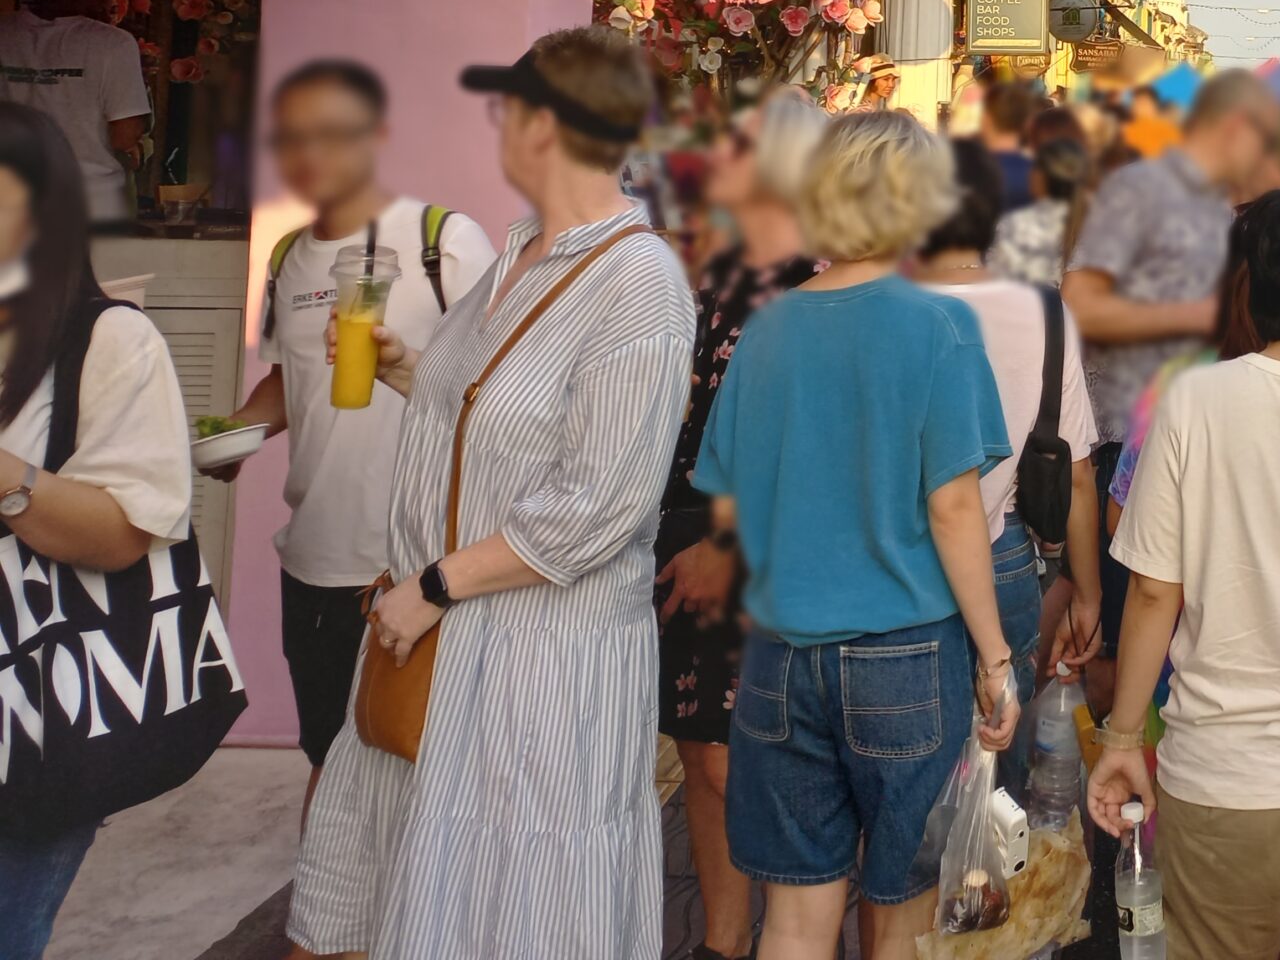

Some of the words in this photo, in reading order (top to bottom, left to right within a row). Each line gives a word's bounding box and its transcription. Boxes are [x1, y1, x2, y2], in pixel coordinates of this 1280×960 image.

[976, 5, 1000, 14] BAR
[976, 16, 1010, 25] FOOD
[976, 27, 1016, 37] SHOPS
